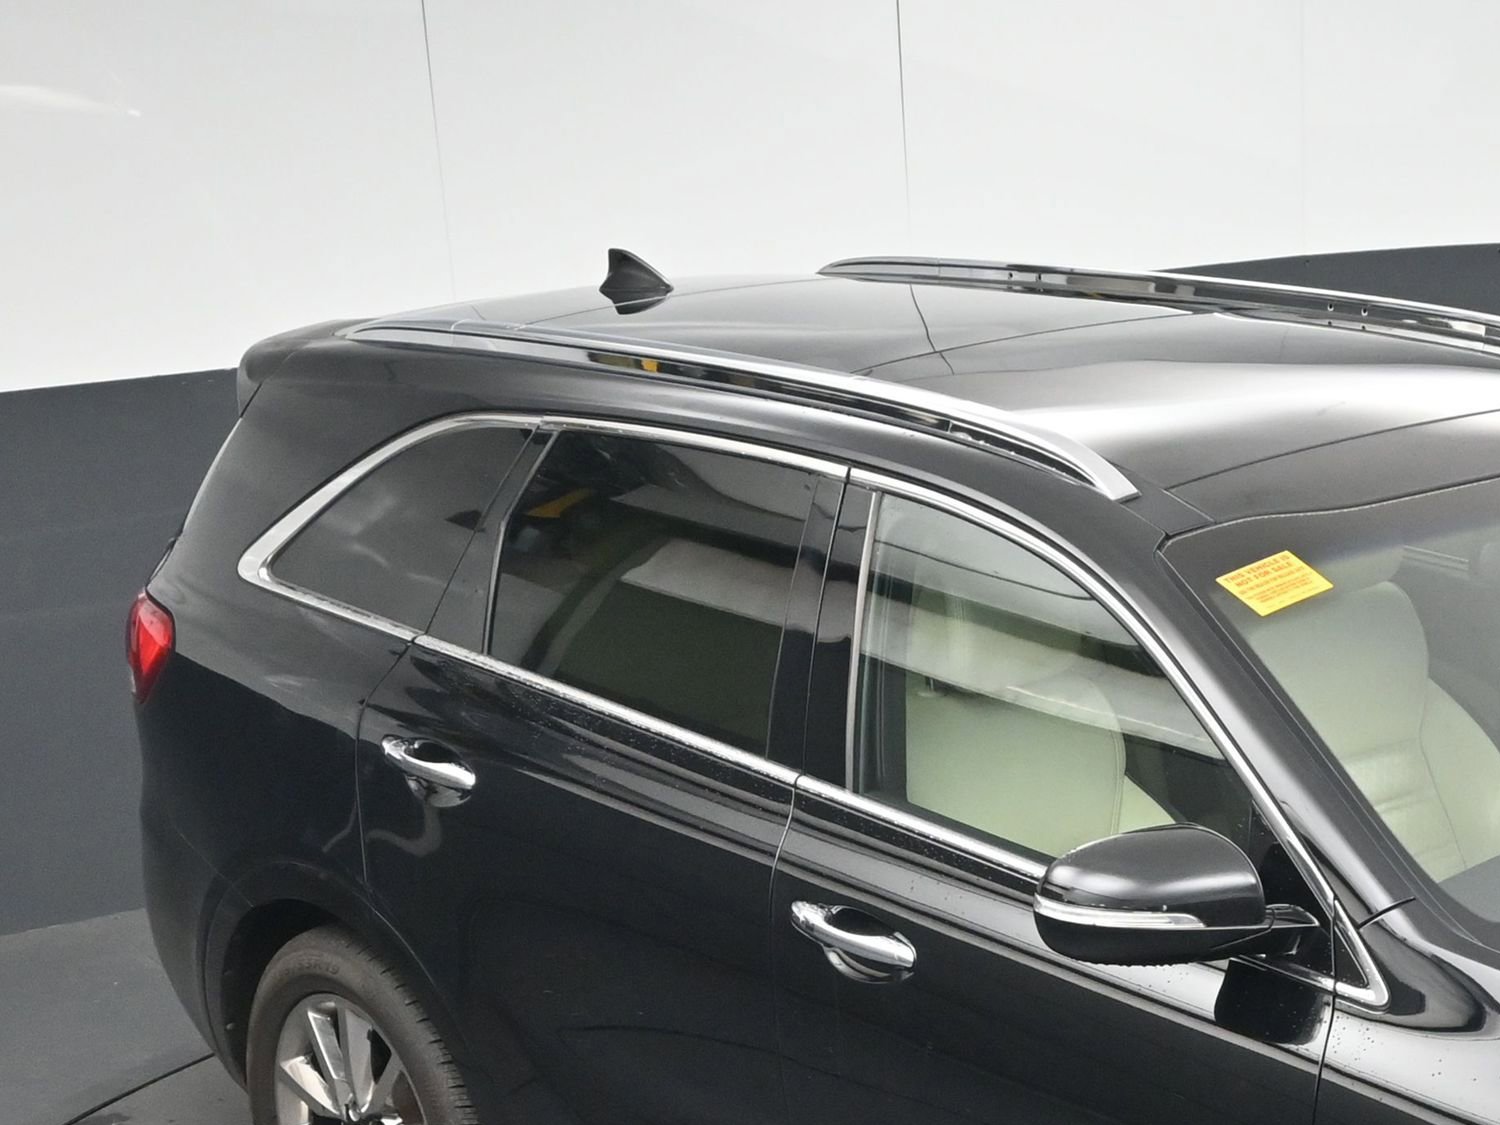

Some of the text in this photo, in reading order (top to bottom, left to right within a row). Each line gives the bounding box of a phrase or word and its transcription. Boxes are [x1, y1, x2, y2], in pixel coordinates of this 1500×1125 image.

[1223, 571, 1246, 583] THIS
[1244, 557, 1281, 575] VEHICLE
[1234, 561, 1294, 587] NOT FOR SALE
